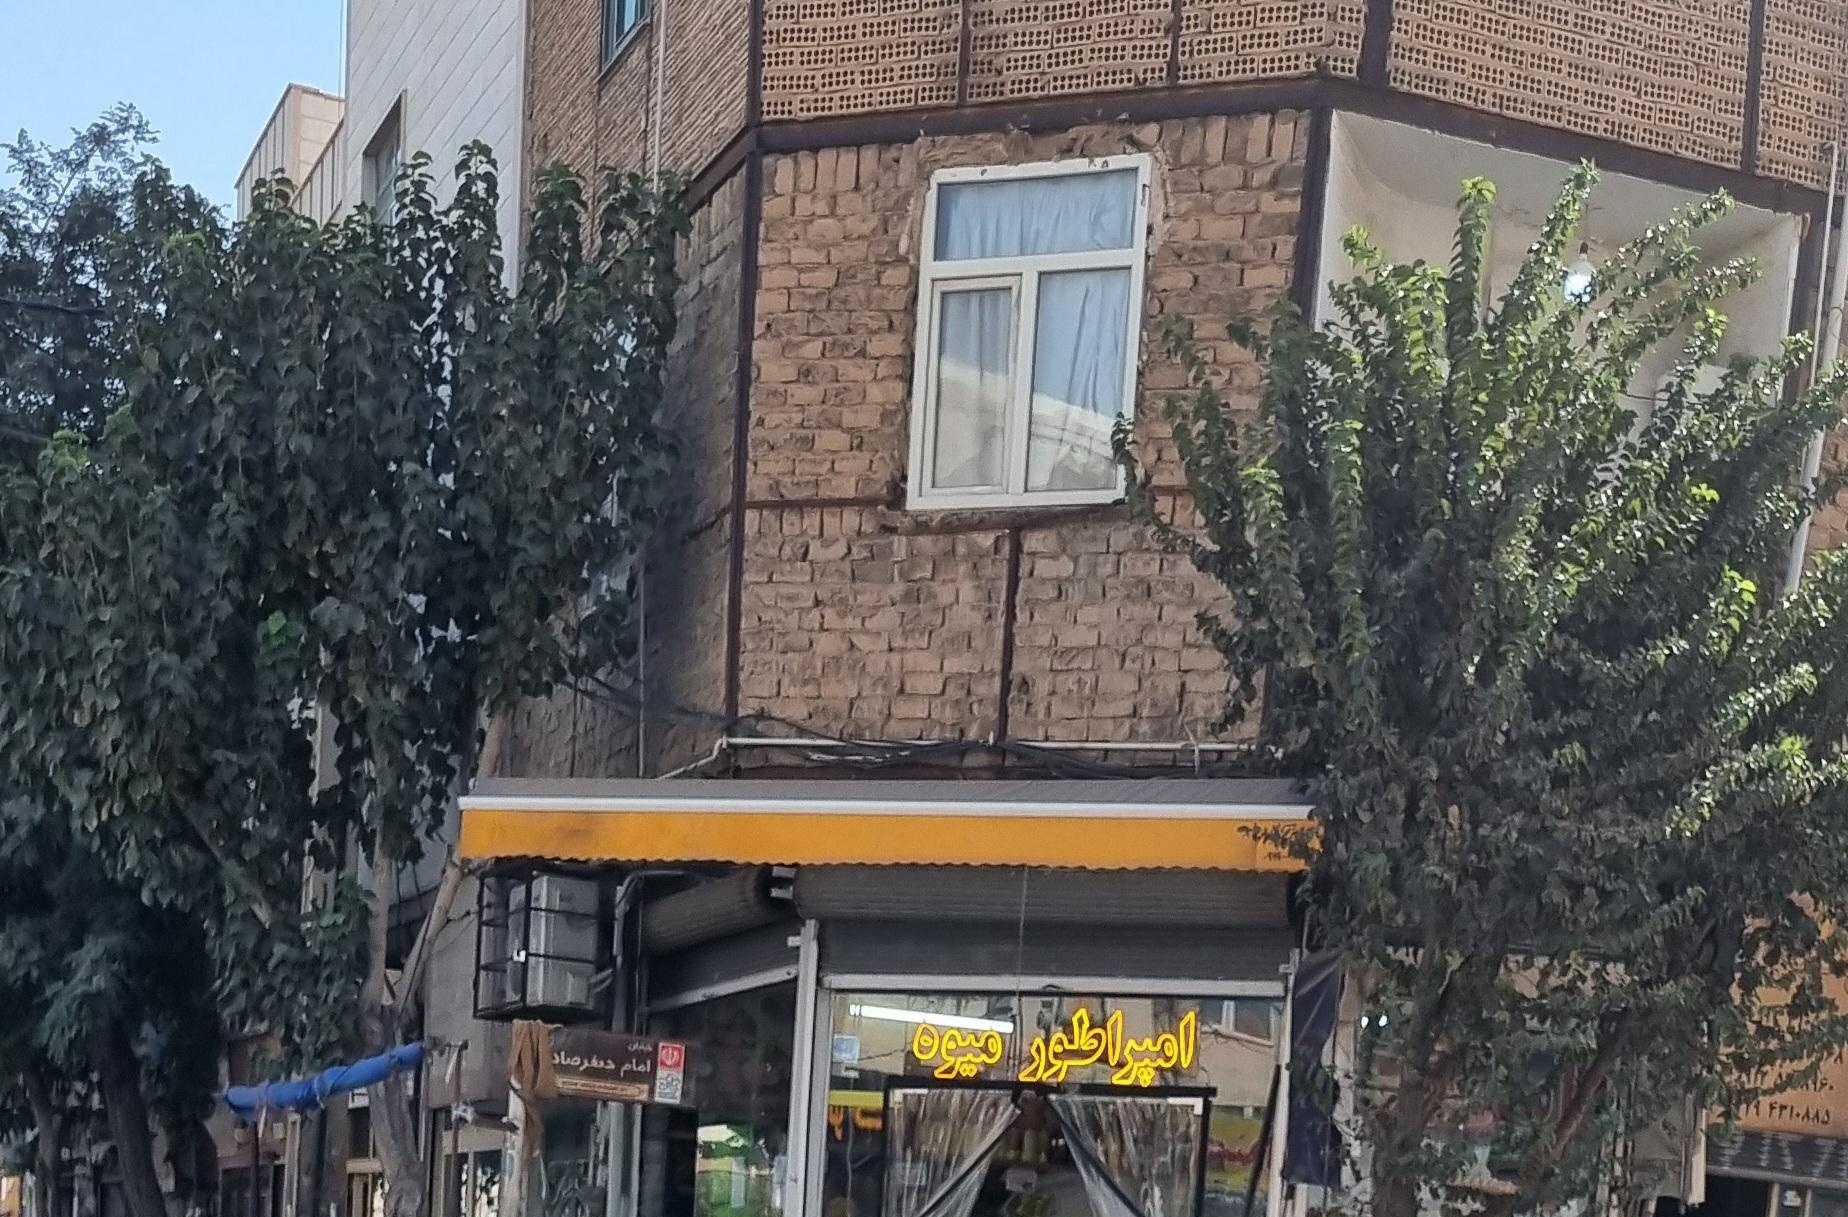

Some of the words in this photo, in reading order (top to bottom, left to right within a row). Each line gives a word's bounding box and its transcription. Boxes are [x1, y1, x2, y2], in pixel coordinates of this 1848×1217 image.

[620, 1058, 650, 1078] امام
[912, 1022, 1003, 1079] میوه
[1018, 1008, 1197, 1088] امپراطور
